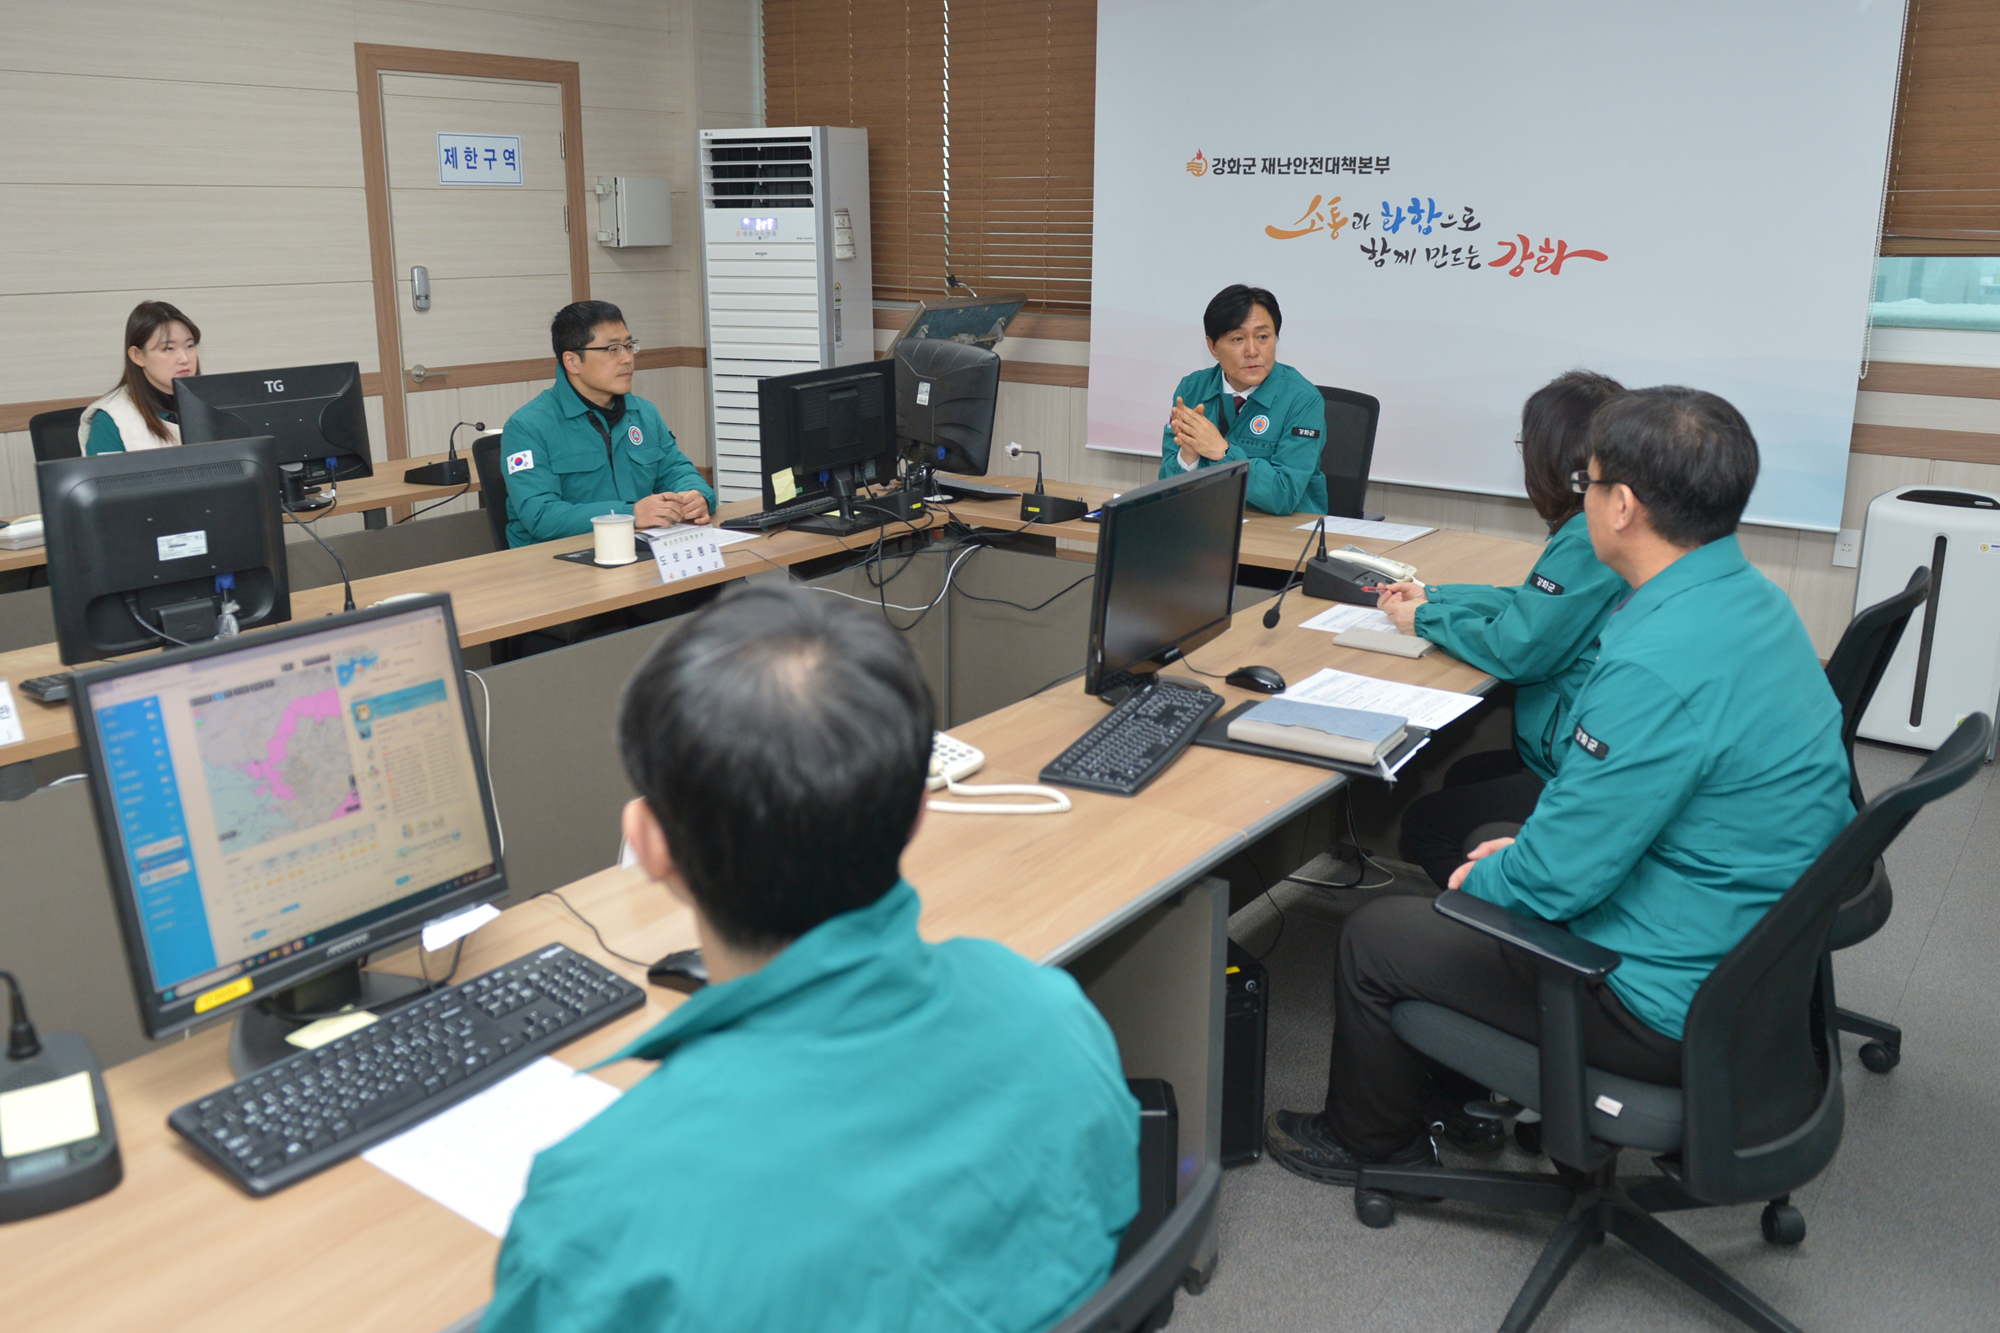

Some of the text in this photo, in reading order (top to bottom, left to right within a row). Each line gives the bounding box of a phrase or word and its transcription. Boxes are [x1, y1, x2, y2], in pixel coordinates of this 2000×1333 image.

[443, 146, 516, 171] 제한구역
[1211, 156, 1391, 176] 강화군 재난안전대책본부
[1265, 194, 1482, 240] 소통과 화합으로
[1360, 233, 1609, 278] 함께 만드는 강화
[263, 379, 285, 393] TG
